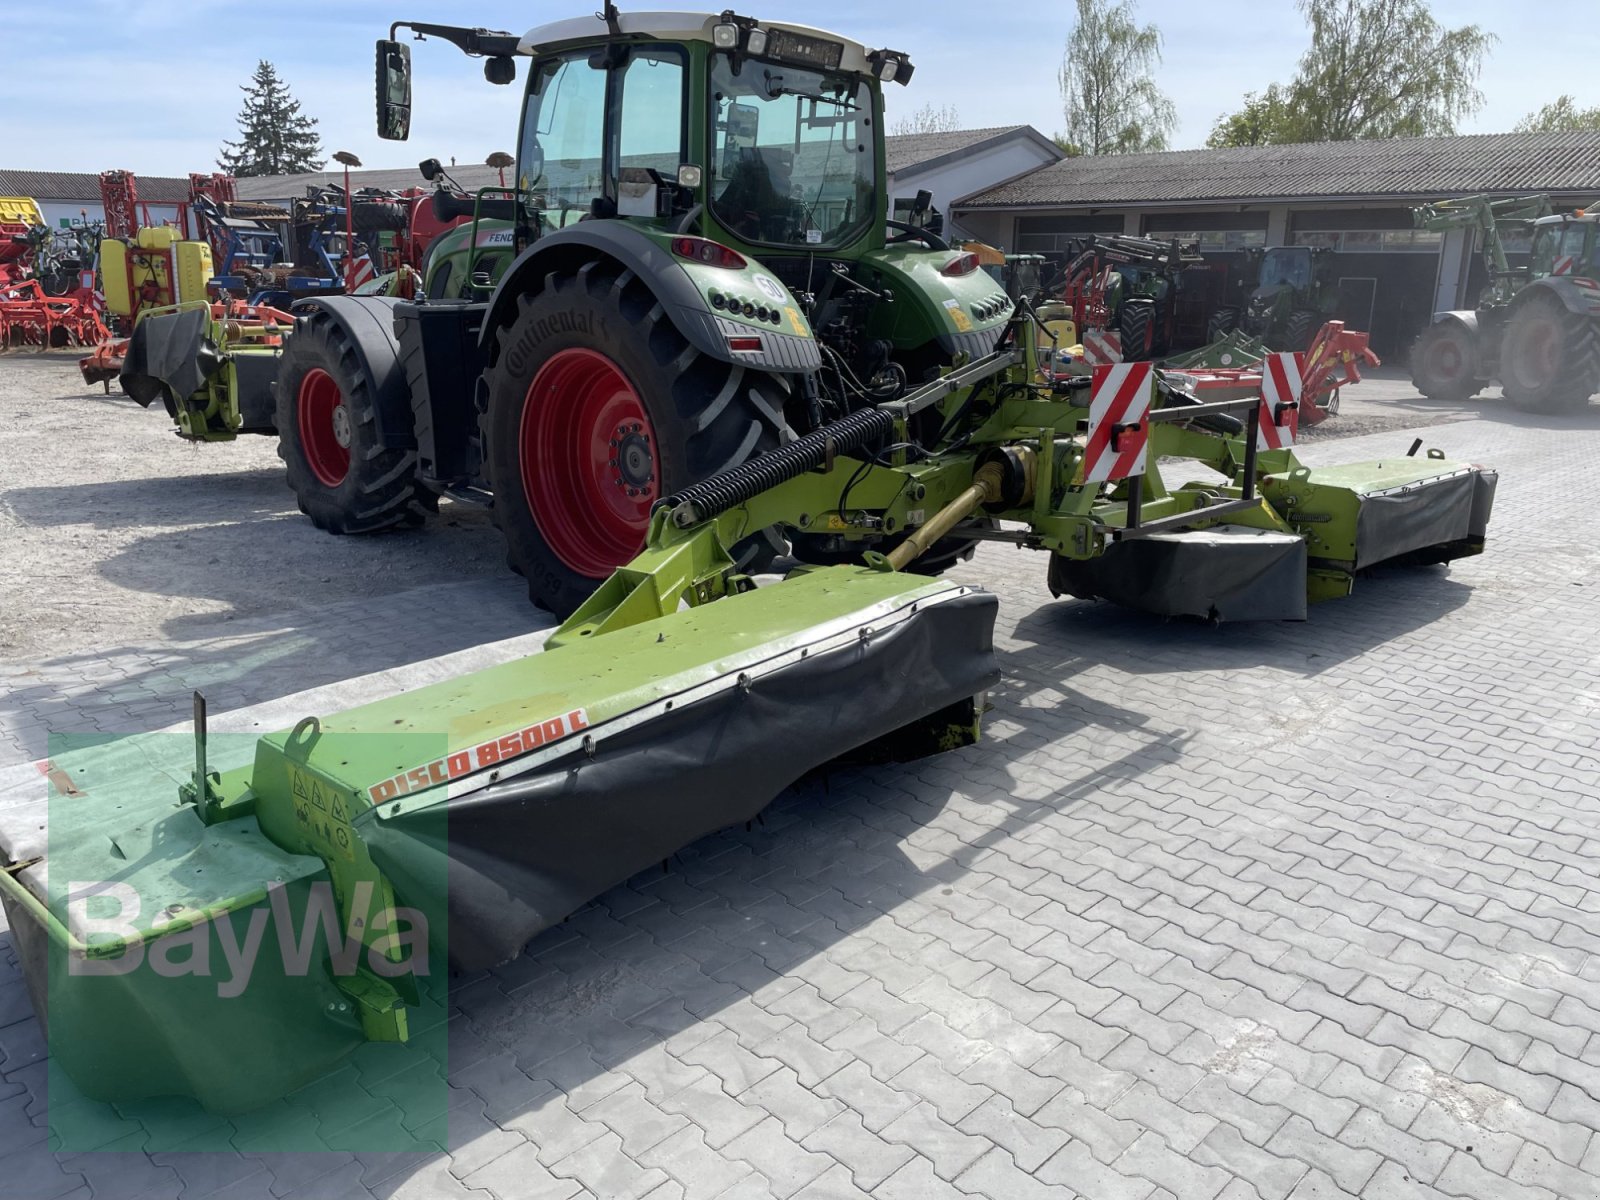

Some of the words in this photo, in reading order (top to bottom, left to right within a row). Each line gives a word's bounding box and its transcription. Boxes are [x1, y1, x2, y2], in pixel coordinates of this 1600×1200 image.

[489, 233, 514, 243] FEND
[756, 276, 783, 299] 50
[505, 309, 595, 378] Continental
[369, 751, 471, 805] DISCO
[476, 717, 565, 766] 8500
[568, 709, 587, 732] C
